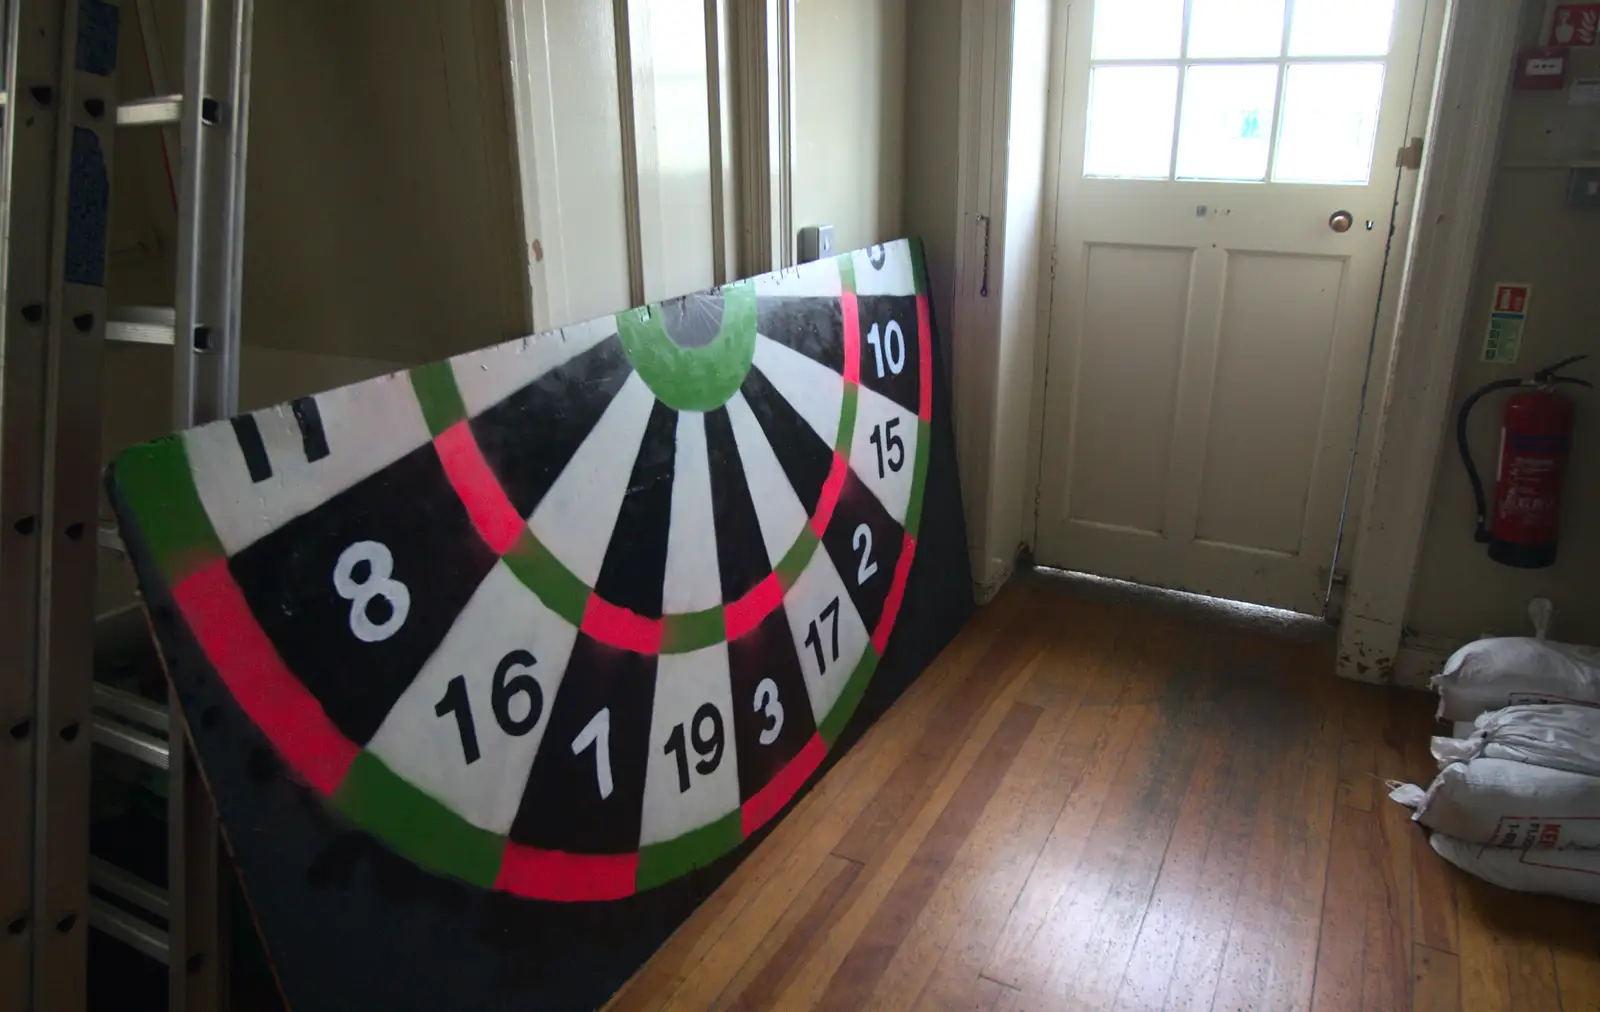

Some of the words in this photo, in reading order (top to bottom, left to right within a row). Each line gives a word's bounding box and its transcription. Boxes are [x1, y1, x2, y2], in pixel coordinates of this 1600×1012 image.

[867, 320, 905, 377] 10
[869, 417, 905, 480] 15
[333, 541, 410, 643] 8
[852, 524, 878, 585] 2
[805, 596, 840, 675] 17
[434, 650, 544, 765] 16
[753, 678, 784, 745] 3
[571, 708, 613, 799] 1
[664, 703, 725, 793] 19
